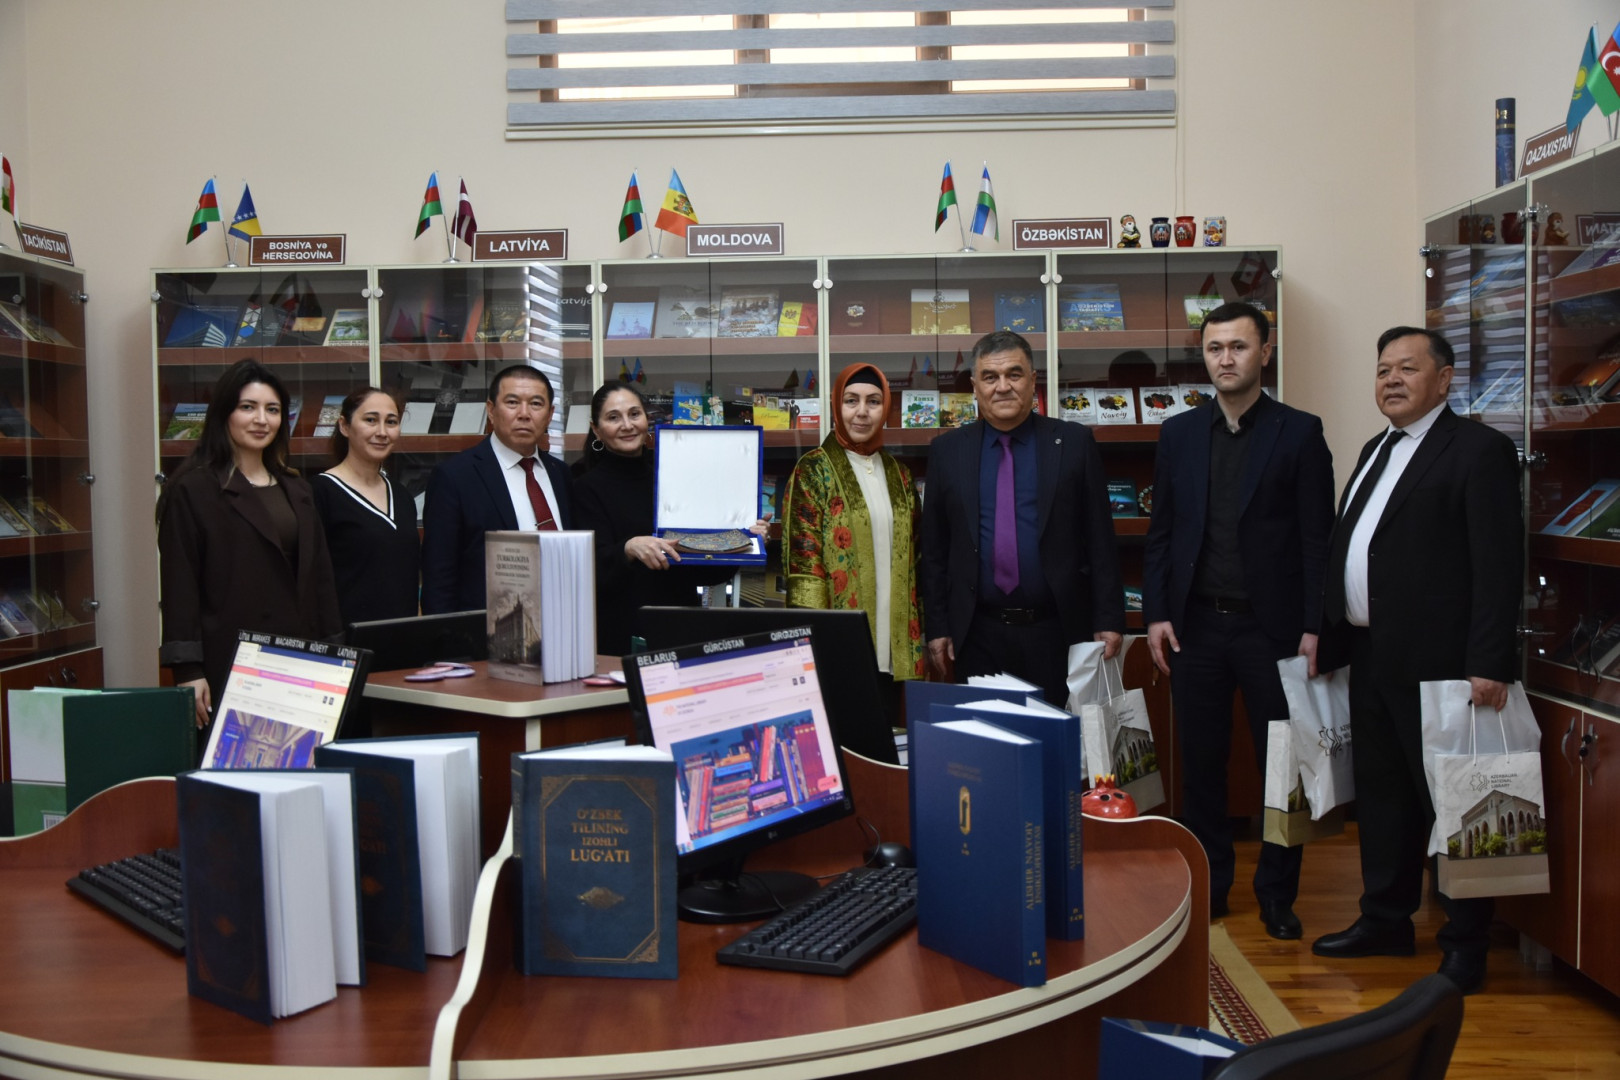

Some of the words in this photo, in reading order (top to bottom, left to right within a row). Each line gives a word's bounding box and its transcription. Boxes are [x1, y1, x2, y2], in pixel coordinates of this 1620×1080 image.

[1525, 132, 1575, 166] QAZAXISTAN
[697, 233, 773, 246] MOLDOVA
[1021, 226, 1103, 241] ÖZBƏKİSTAN
[22, 233, 67, 255] TACİKİSTAN
[269, 240, 312, 250] BOSNİYA
[489, 237, 550, 253] LATVİYA
[262, 250, 333, 260] HERSEQOVİNA
[636, 651, 677, 666] BELARUS
[703, 639, 744, 653] GÜRCÜSTAN
